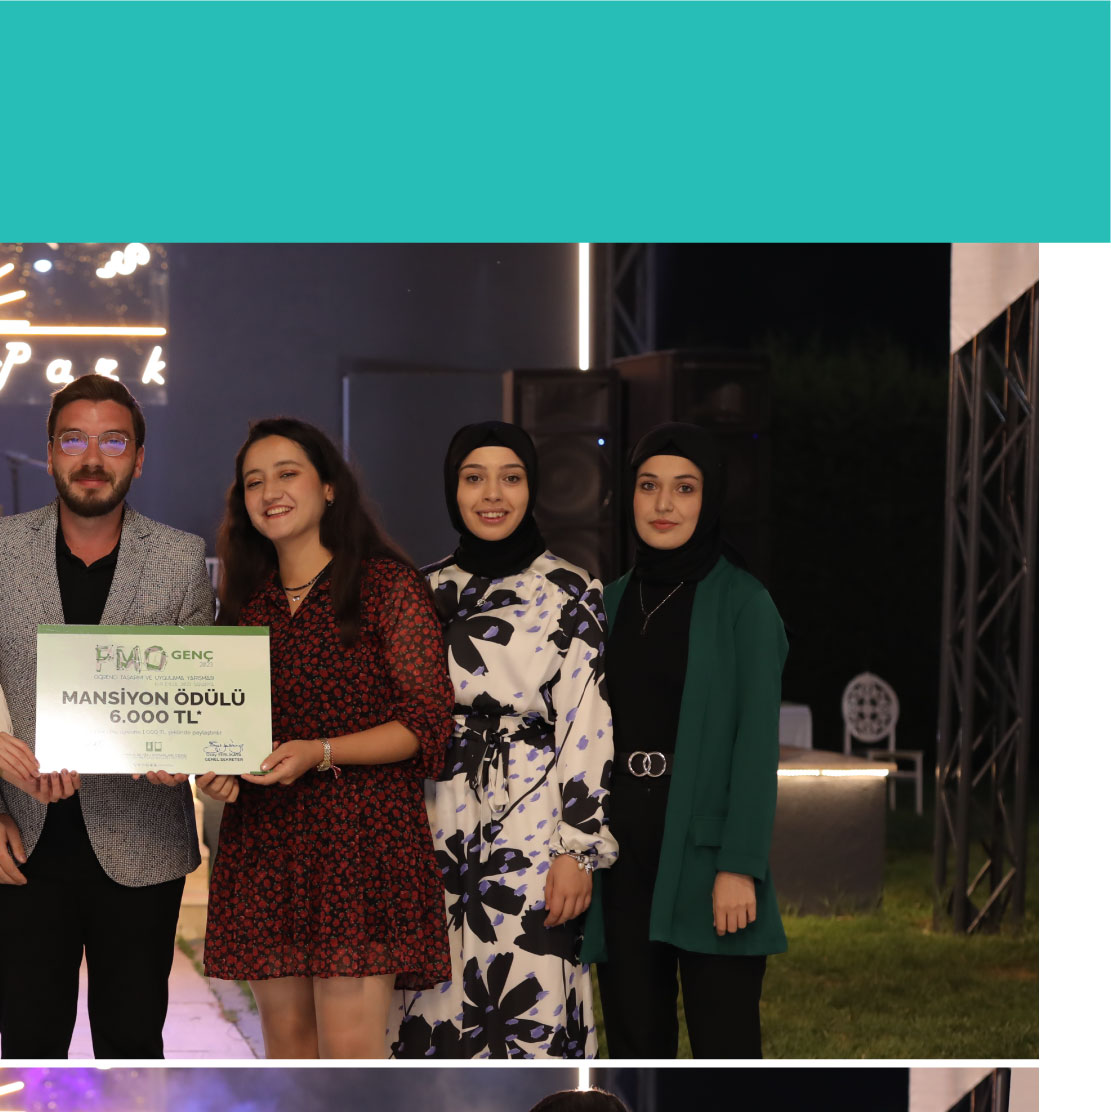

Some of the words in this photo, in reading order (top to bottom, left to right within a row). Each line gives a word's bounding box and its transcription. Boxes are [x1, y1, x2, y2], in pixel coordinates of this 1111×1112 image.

[95, 644, 168, 673] PMO
[171, 650, 214, 662] GENÇ
[62, 687, 169, 705] MANSİYON
[174, 688, 246, 706] ÖDÜLÜ
[110, 709, 169, 724] 6.000
